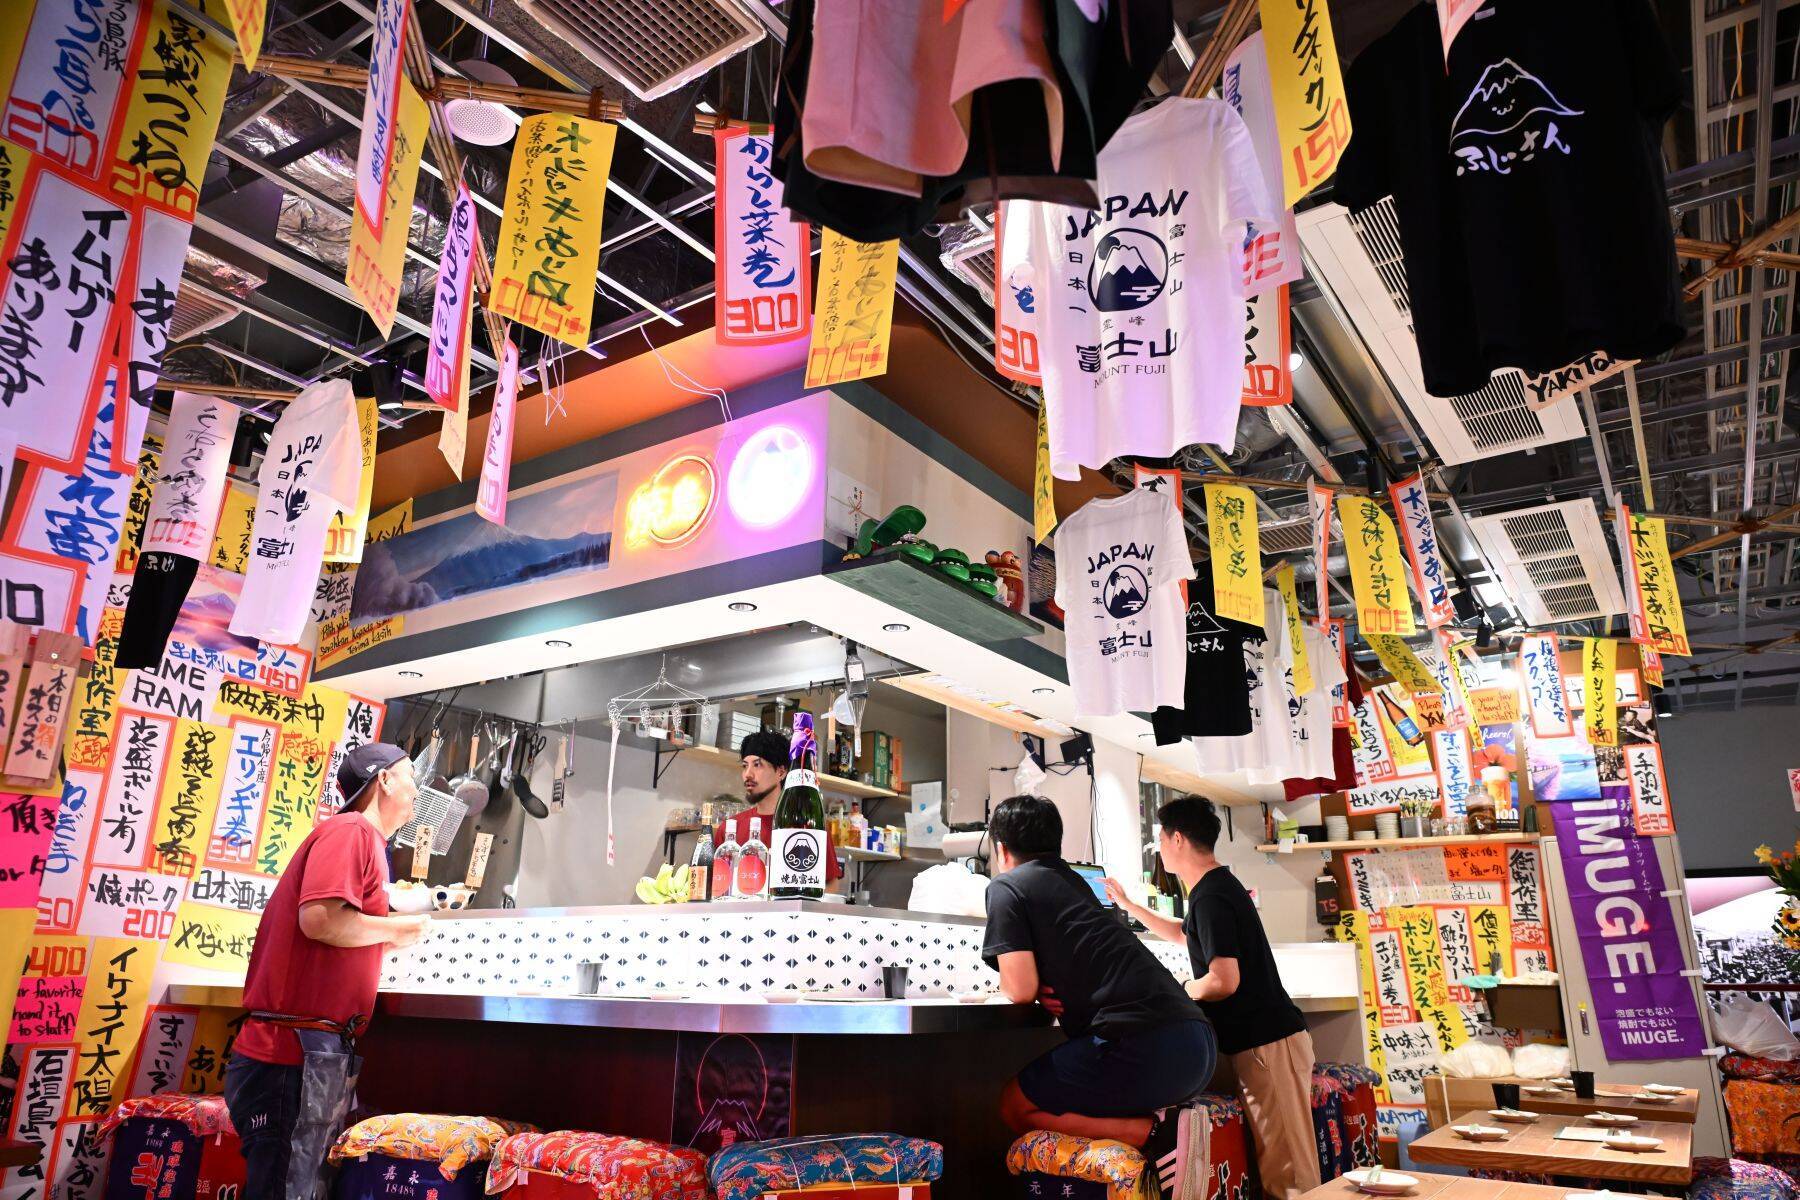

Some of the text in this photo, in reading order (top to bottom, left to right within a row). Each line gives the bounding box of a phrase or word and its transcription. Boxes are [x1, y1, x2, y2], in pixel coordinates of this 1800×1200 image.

[1293, 98, 1349, 188] 150
[739, 136, 796, 290] からし菜巻
[1066, 188, 1189, 241] JAPAN
[1169, 223, 1186, 296] 富士山
[64, 210, 127, 353] イムゲー
[1068, 251, 1087, 314] 日本一
[726, 293, 798, 335] 300
[1076, 328, 1178, 373] 富士山
[1135, 364, 1167, 375] FUJI
[1087, 542, 1155, 574] JAPAN
[1091, 580, 1104, 619] 日本一
[1098, 630, 1153, 656] 富士山
[133, 675, 202, 721] RAM
[258, 665, 300, 694] 450
[15, 683, 49, 756] オススメ
[219, 735, 262, 848] エリンギ巻
[297, 757, 323, 818] シンバ
[1633, 752, 1662, 806] 手羽先
[3, 795, 57, 836] 頂き
[257, 759, 297, 876] ホールディングス
[89, 873, 179, 912] 焼ポーク
[781, 874, 820, 885] 焼鳥富士山
[1451, 882, 1491, 900] 富士山
[1509, 849, 1540, 922] 街制作室
[1571, 798, 1657, 994] IMUGE.
[123, 907, 177, 939] 200
[1419, 919, 1440, 970] シンバ
[28, 946, 87, 977] 400
[1375, 940, 1403, 1006] エリンギ巻
[1402, 921, 1431, 1009] ホールディングス
[33, 978, 83, 998] favorite
[12, 1001, 45, 1021] hand
[17, 1023, 32, 1036] to
[73, 946, 138, 1117] イケナイ太陽
[1616, 1007, 1674, 1018] 泡盛でもない
[1618, 1018, 1677, 1030] 焼酎でもない
[147, 1015, 185, 1096] すごいぞ
[1383, 1027, 1433, 1050] 中味汁
[1621, 1029, 1685, 1045] IMUGE.
[382, 1165, 419, 1185] 嘉永
